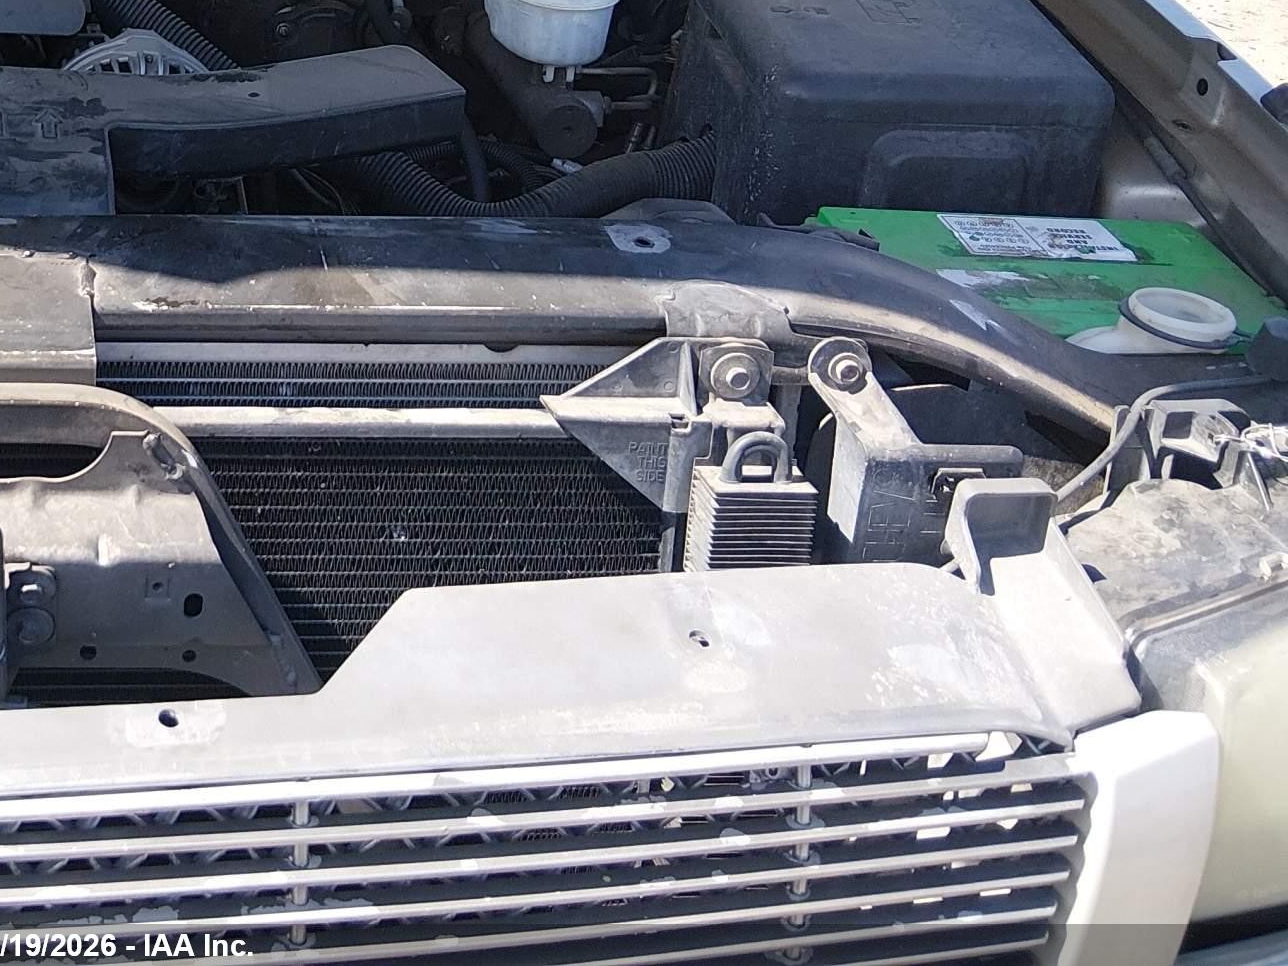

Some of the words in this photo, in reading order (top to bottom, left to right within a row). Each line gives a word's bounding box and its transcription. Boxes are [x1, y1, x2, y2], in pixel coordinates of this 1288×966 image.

[628, 441, 669, 456] PAINT
[637, 456, 667, 468] THIS
[635, 469, 665, 483] SIDE
